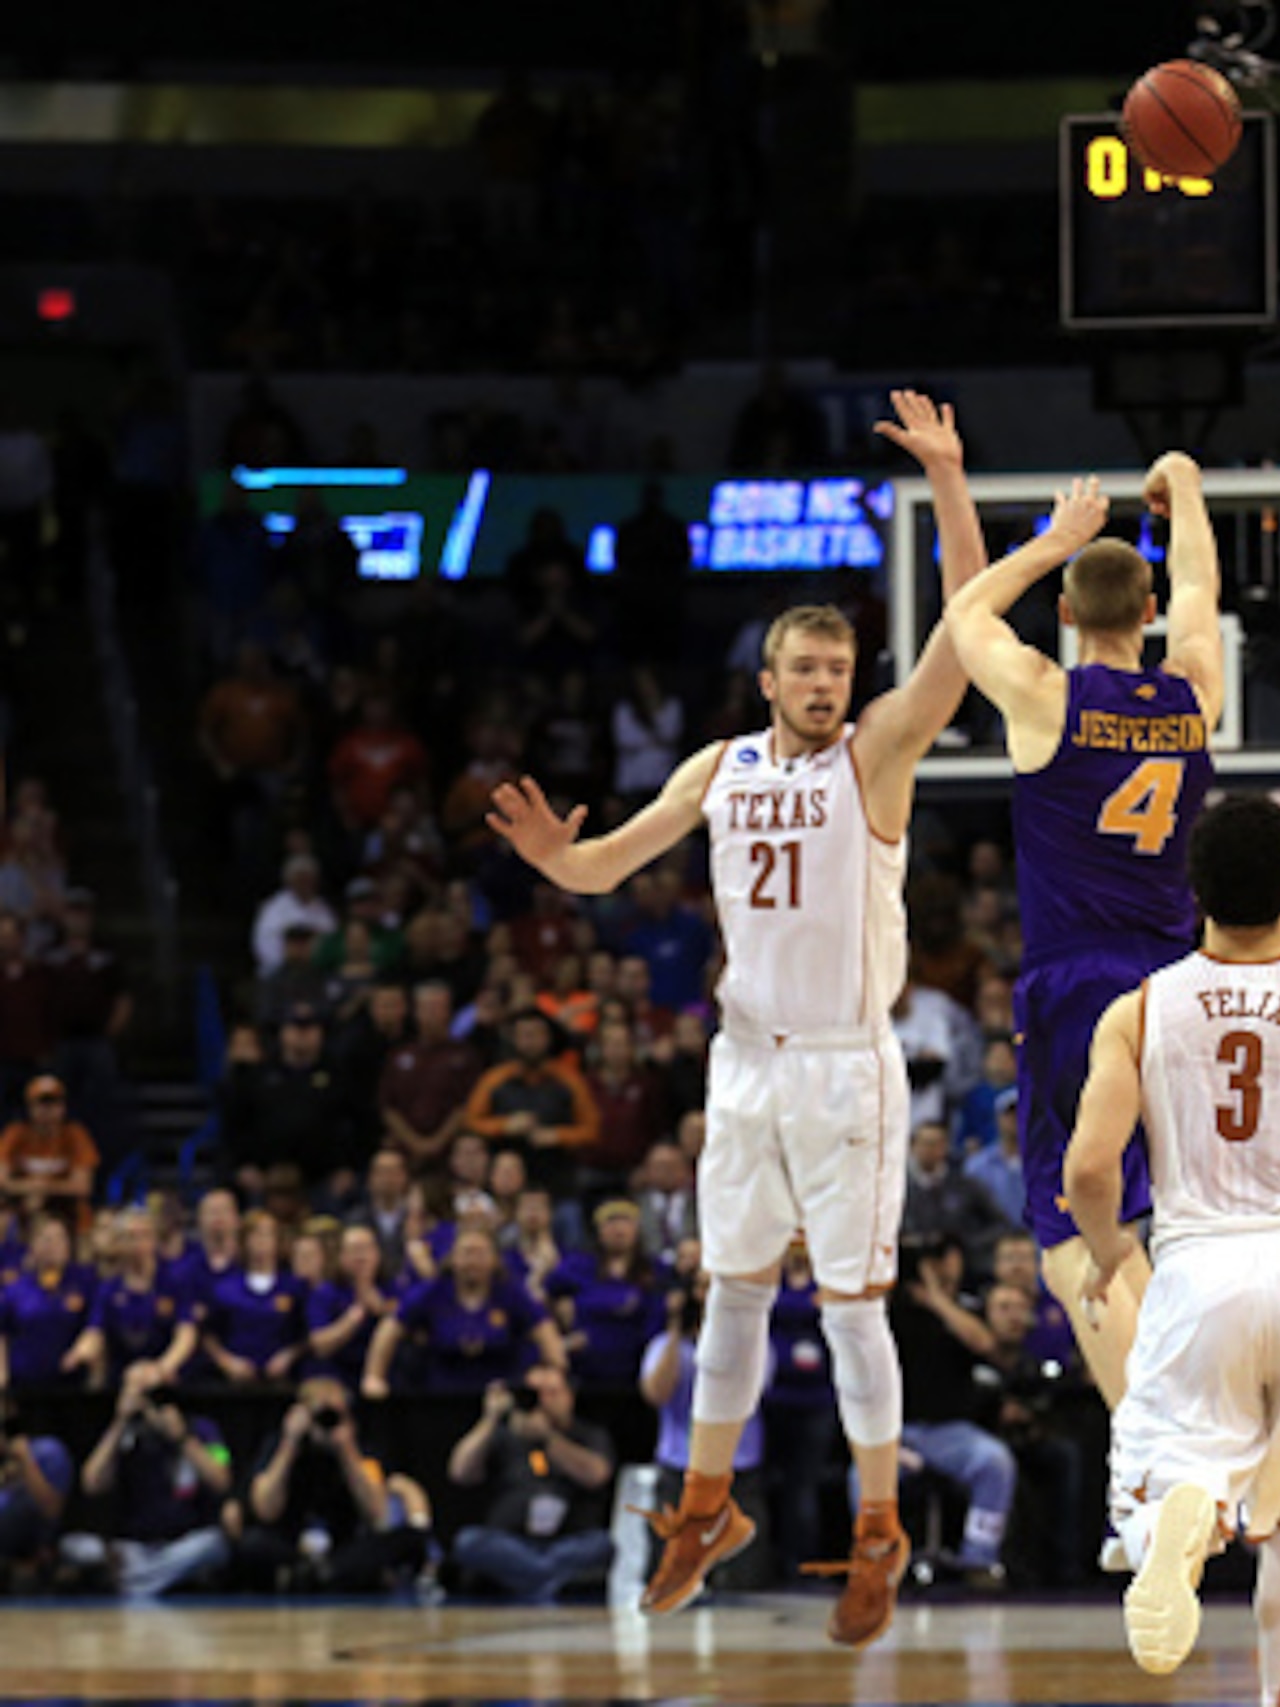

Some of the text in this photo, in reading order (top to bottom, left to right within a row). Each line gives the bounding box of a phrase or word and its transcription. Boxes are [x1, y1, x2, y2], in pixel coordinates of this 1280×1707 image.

[1072, 709, 1205, 752] JESPERSON
[728, 788, 827, 829] TEXAS
[1098, 757, 1186, 856] 4
[749, 840, 802, 909] 21
[1216, 1030, 1263, 1142] 3
